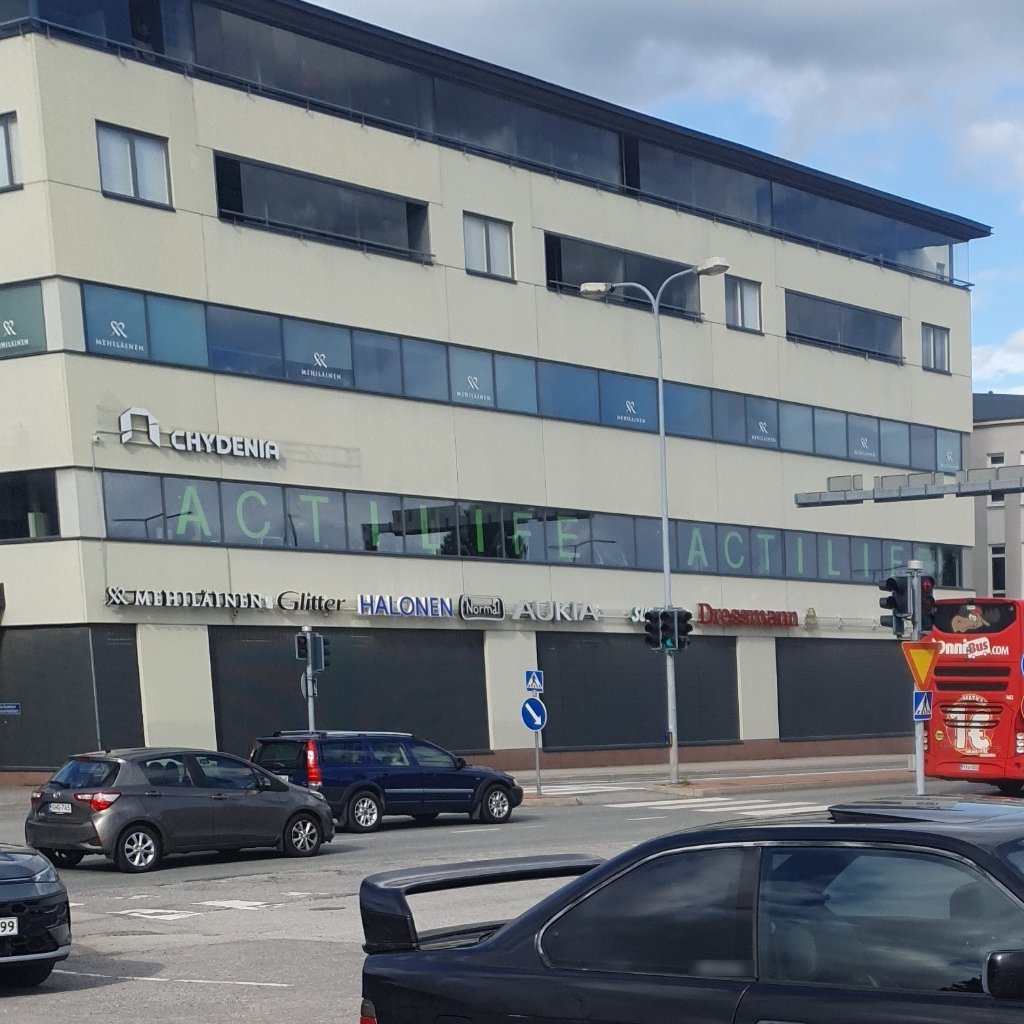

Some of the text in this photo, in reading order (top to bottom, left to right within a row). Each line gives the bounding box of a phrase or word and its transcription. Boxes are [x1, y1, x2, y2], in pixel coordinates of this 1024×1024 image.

[170, 430, 280, 460] CHYDENIA
[176, 485, 581, 558] ACTILIFE
[276, 590, 346, 612] Glitter
[357, 593, 455, 618] HALONEN
[465, 600, 500, 616] Normal
[512, 600, 600, 622] AUKIA
[697, 602, 799, 627] Dressmann
